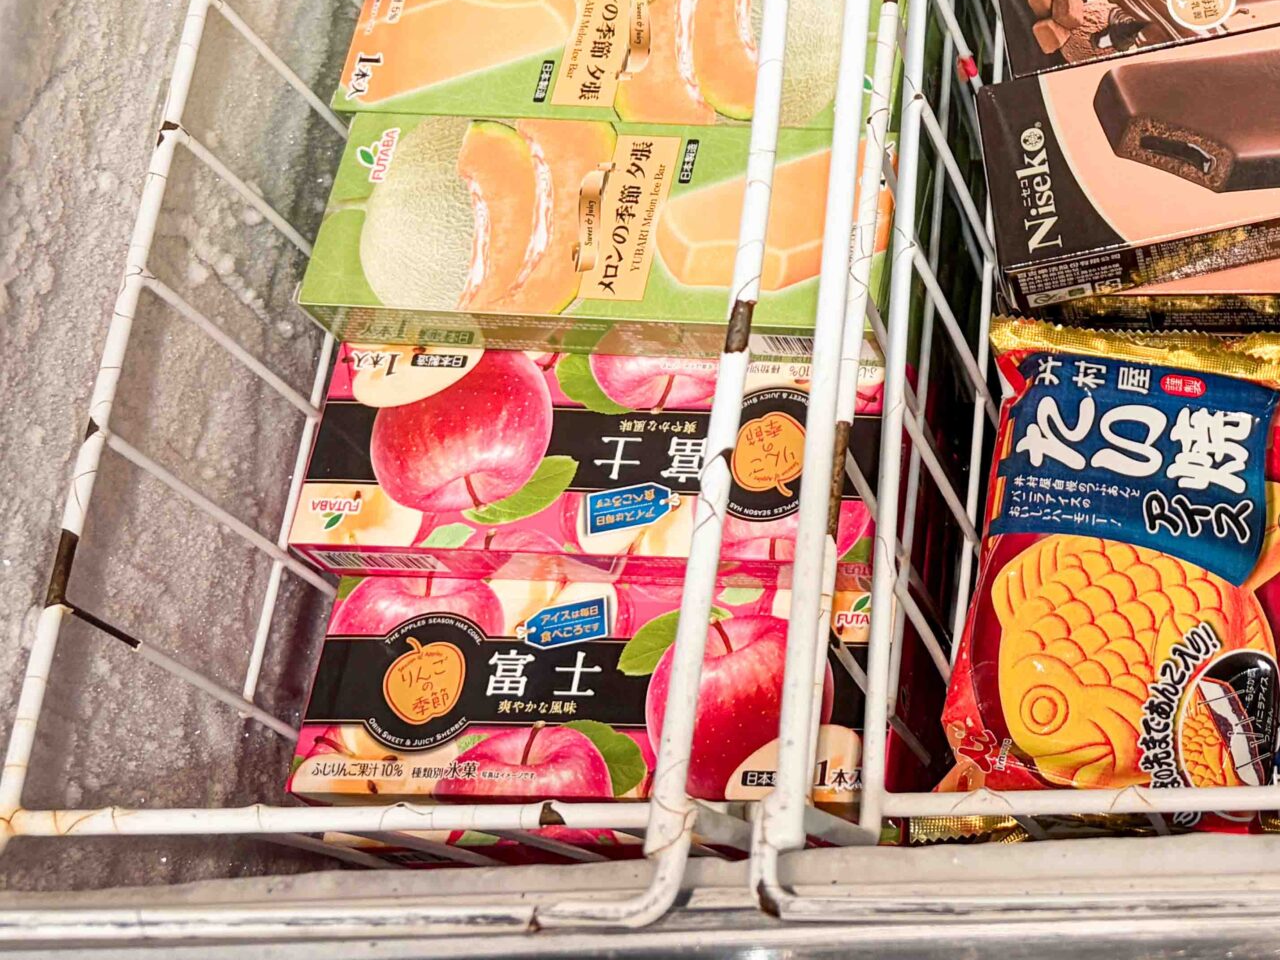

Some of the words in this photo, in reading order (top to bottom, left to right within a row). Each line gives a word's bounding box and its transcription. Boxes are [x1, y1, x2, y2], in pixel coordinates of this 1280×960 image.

[350, 52, 382, 97] 1本入
[536, 62, 553, 101] 日本製造
[578, 64, 606, 101] 夕張
[371, 130, 400, 181] FUTABA
[681, 142, 699, 181] 日本製造
[652, 163, 666, 181] Bar
[647, 182, 659, 197] Ice
[1015, 123, 1063, 254] Niseko
[598, 184, 643, 295] メロンの季節
[626, 140, 654, 179] 夕張
[641, 198, 657, 227] Melon
[629, 229, 649, 272] YUBARI
[353, 353, 401, 377] 1本入
[416, 354, 464, 367] 日本製造
[1034, 356, 1151, 394] 井村屋
[618, 418, 698, 434] 爽やかな風味
[1015, 394, 1253, 494] たい焼
[593, 436, 708, 484] 富士
[311, 500, 361, 512] FUTABA
[595, 488, 656, 509] 食べころです
[1010, 489, 1092, 508] バニラアイスの
[596, 507, 655, 526] アイスは毎日
[743, 506, 772, 516] SEASON
[1142, 488, 1254, 544] アイス
[401, 620, 426, 635] APPLES
[428, 617, 454, 625] SEASON
[455, 620, 468, 631] HAS
[540, 605, 599, 625] アイスは毎日
[835, 612, 870, 626] FUTA
[540, 623, 600, 643] 食べころです
[401, 655, 449, 688] りんご
[486, 649, 603, 697] 富士
[422, 681, 434, 692] の
[412, 688, 450, 715] 季節
[497, 699, 578, 714] 爽やかな風味
[382, 729, 404, 745] SWEET
[413, 736, 434, 746] JUICY
[436, 716, 467, 741] SHERBET
[311, 762, 379, 777] ふじりんご果汁
[381, 764, 404, 777] 10%
[746, 771, 778, 786] 日本
